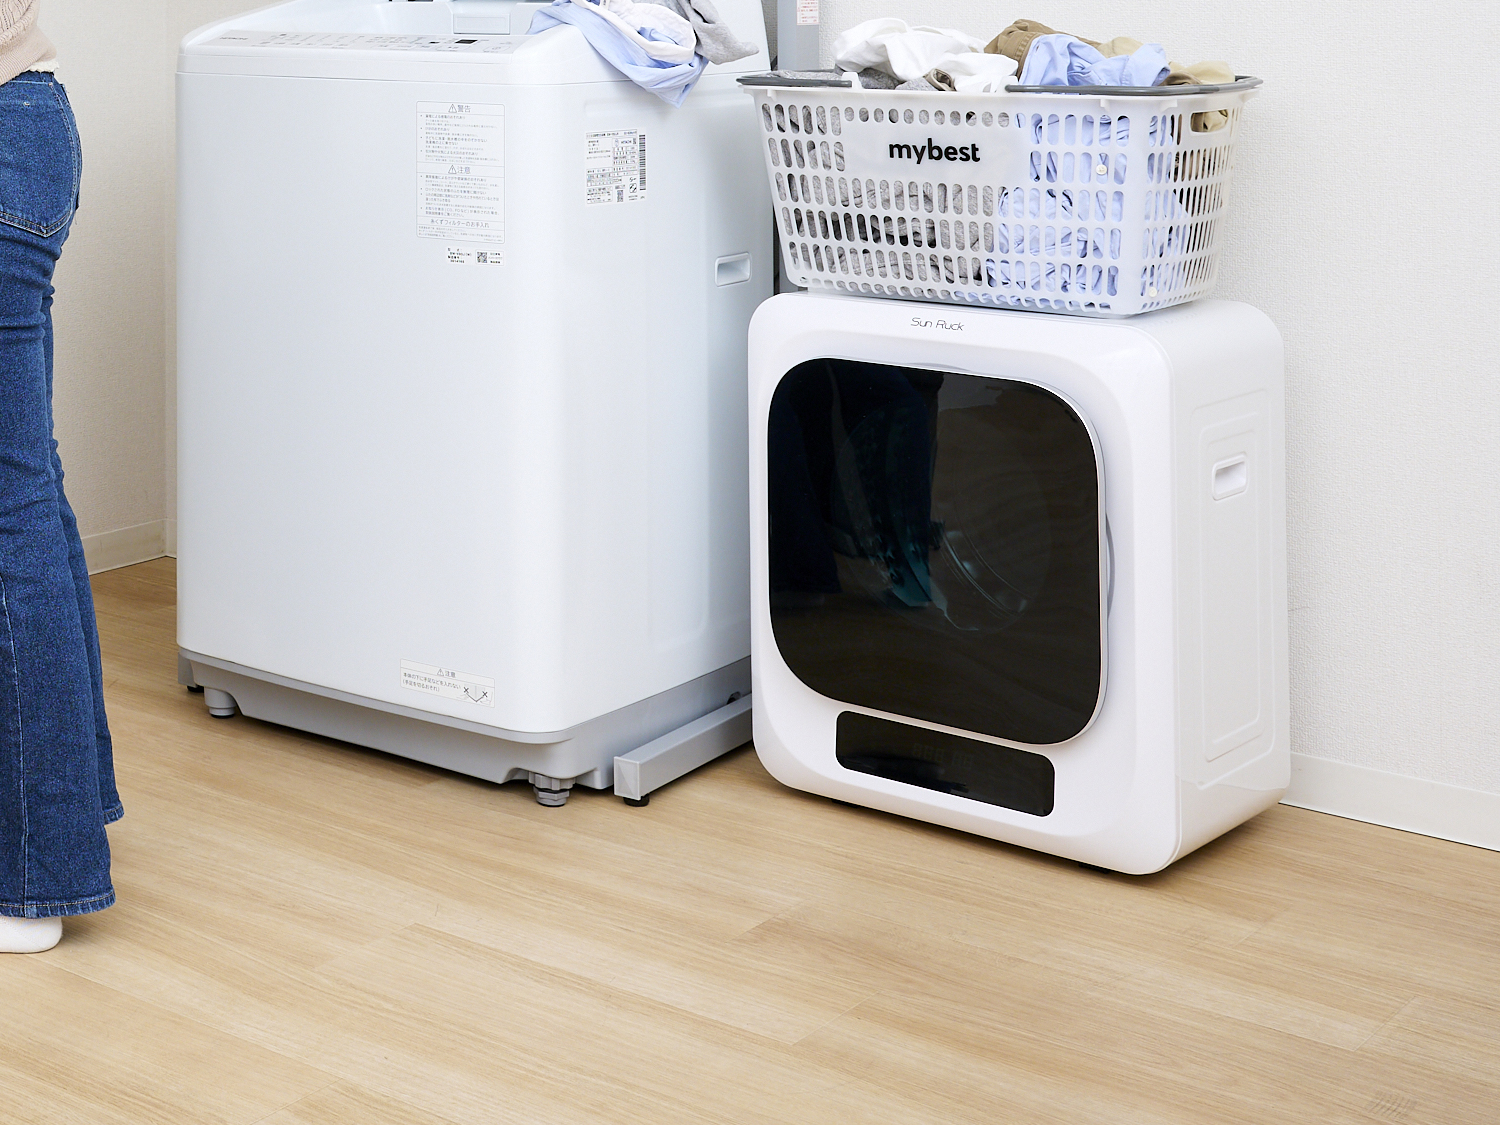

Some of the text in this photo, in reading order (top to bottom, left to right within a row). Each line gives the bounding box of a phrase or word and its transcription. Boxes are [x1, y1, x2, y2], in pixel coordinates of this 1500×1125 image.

[888, 137, 981, 165] mybest
[910, 316, 966, 332] Sun Ruck
